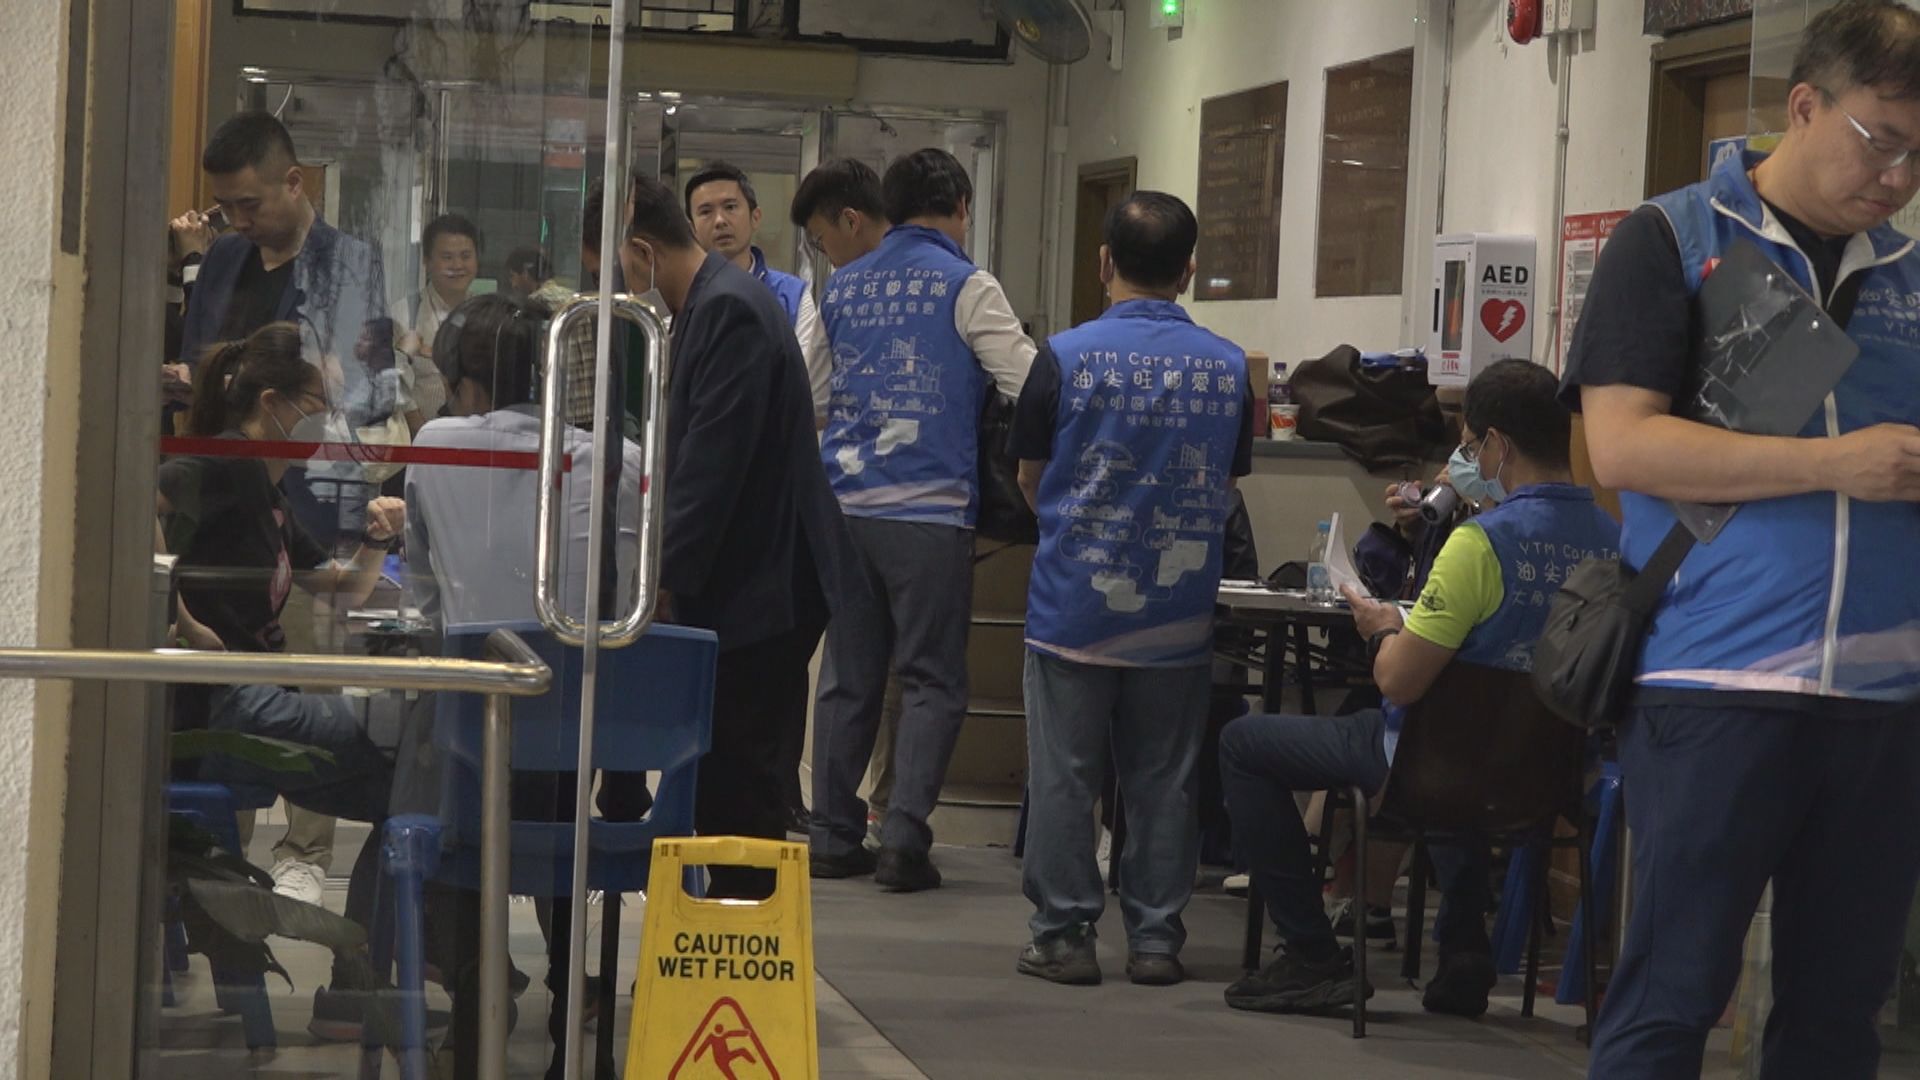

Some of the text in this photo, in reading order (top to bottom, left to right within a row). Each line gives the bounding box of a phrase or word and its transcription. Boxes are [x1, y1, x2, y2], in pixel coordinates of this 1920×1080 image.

[863, 270, 897, 279] Care
[906, 267, 943, 279] Team
[1482, 265, 1529, 284] AED
[1079, 352, 1227, 370] YTM Care Team
[1519, 542, 1556, 555] YTM
[674, 932, 779, 956] CAUTION
[658, 957, 794, 981] WET FLOOR
